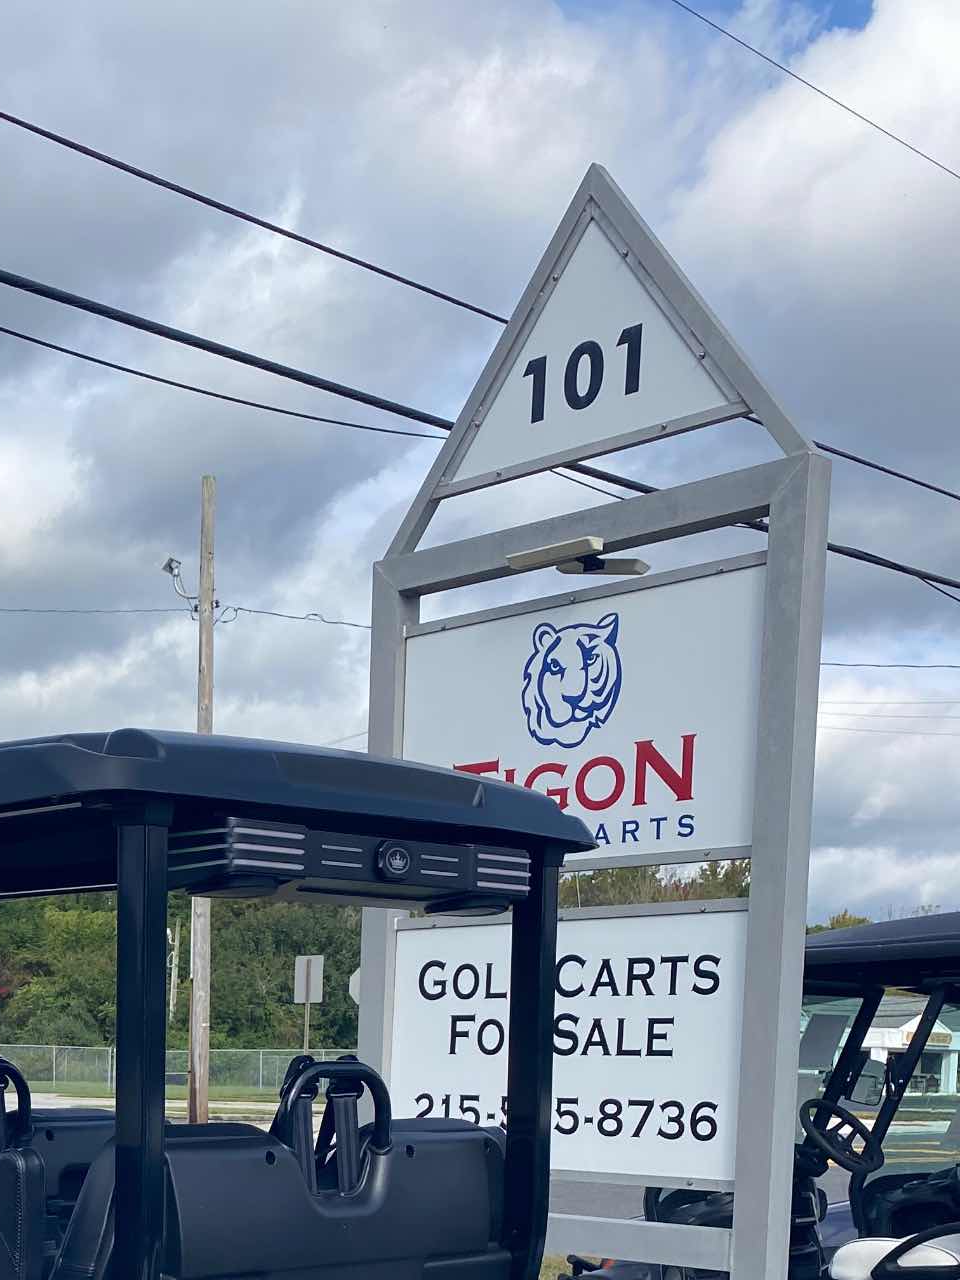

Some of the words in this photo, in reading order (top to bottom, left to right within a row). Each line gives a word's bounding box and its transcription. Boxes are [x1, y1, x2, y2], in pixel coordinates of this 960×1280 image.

[522, 323, 644, 424] 101
[594, 814, 696, 845] ARTS
[418, 959, 508, 1001] GOL
[554, 954, 721, 998] CARTS
[448, 1014, 506, 1055] FO
[553, 1013, 675, 1057] SALE
[414, 1093, 719, 1142] 215-5-8736
